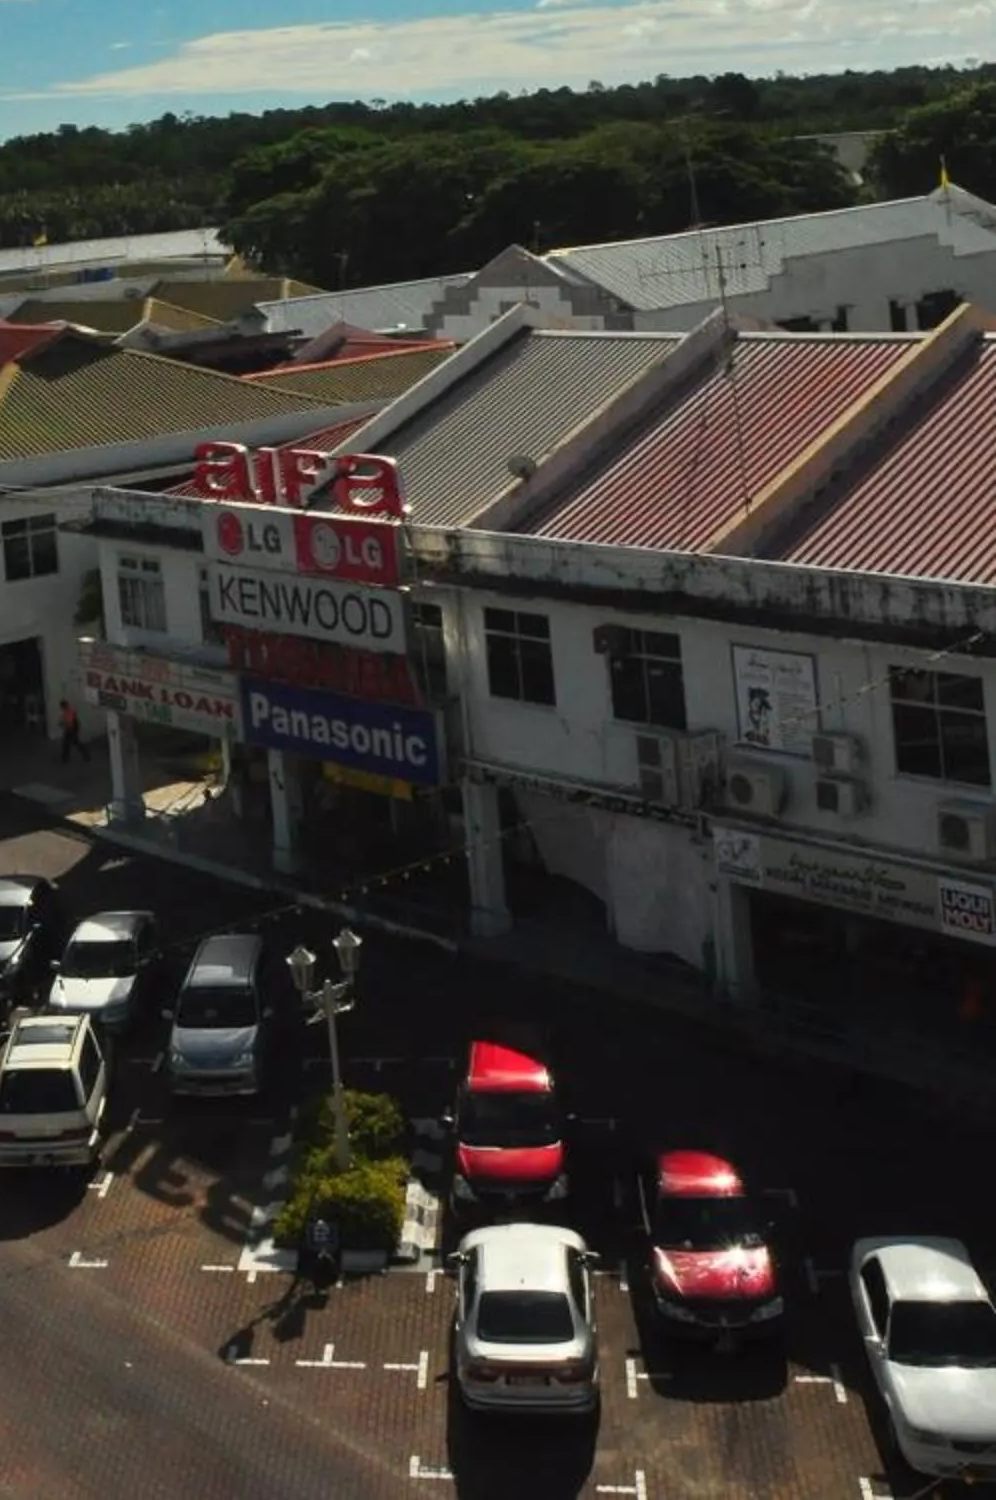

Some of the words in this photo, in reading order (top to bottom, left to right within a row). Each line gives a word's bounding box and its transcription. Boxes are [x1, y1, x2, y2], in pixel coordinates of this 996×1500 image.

[247, 521, 282, 554] LG
[345, 535, 384, 570] LG
[217, 574, 393, 639] KENWOOD
[86, 671, 155, 700] BANK
[160, 688, 234, 718] LOAN
[250, 692, 428, 767] Panasonic
[943, 908, 992, 934] MOLY
